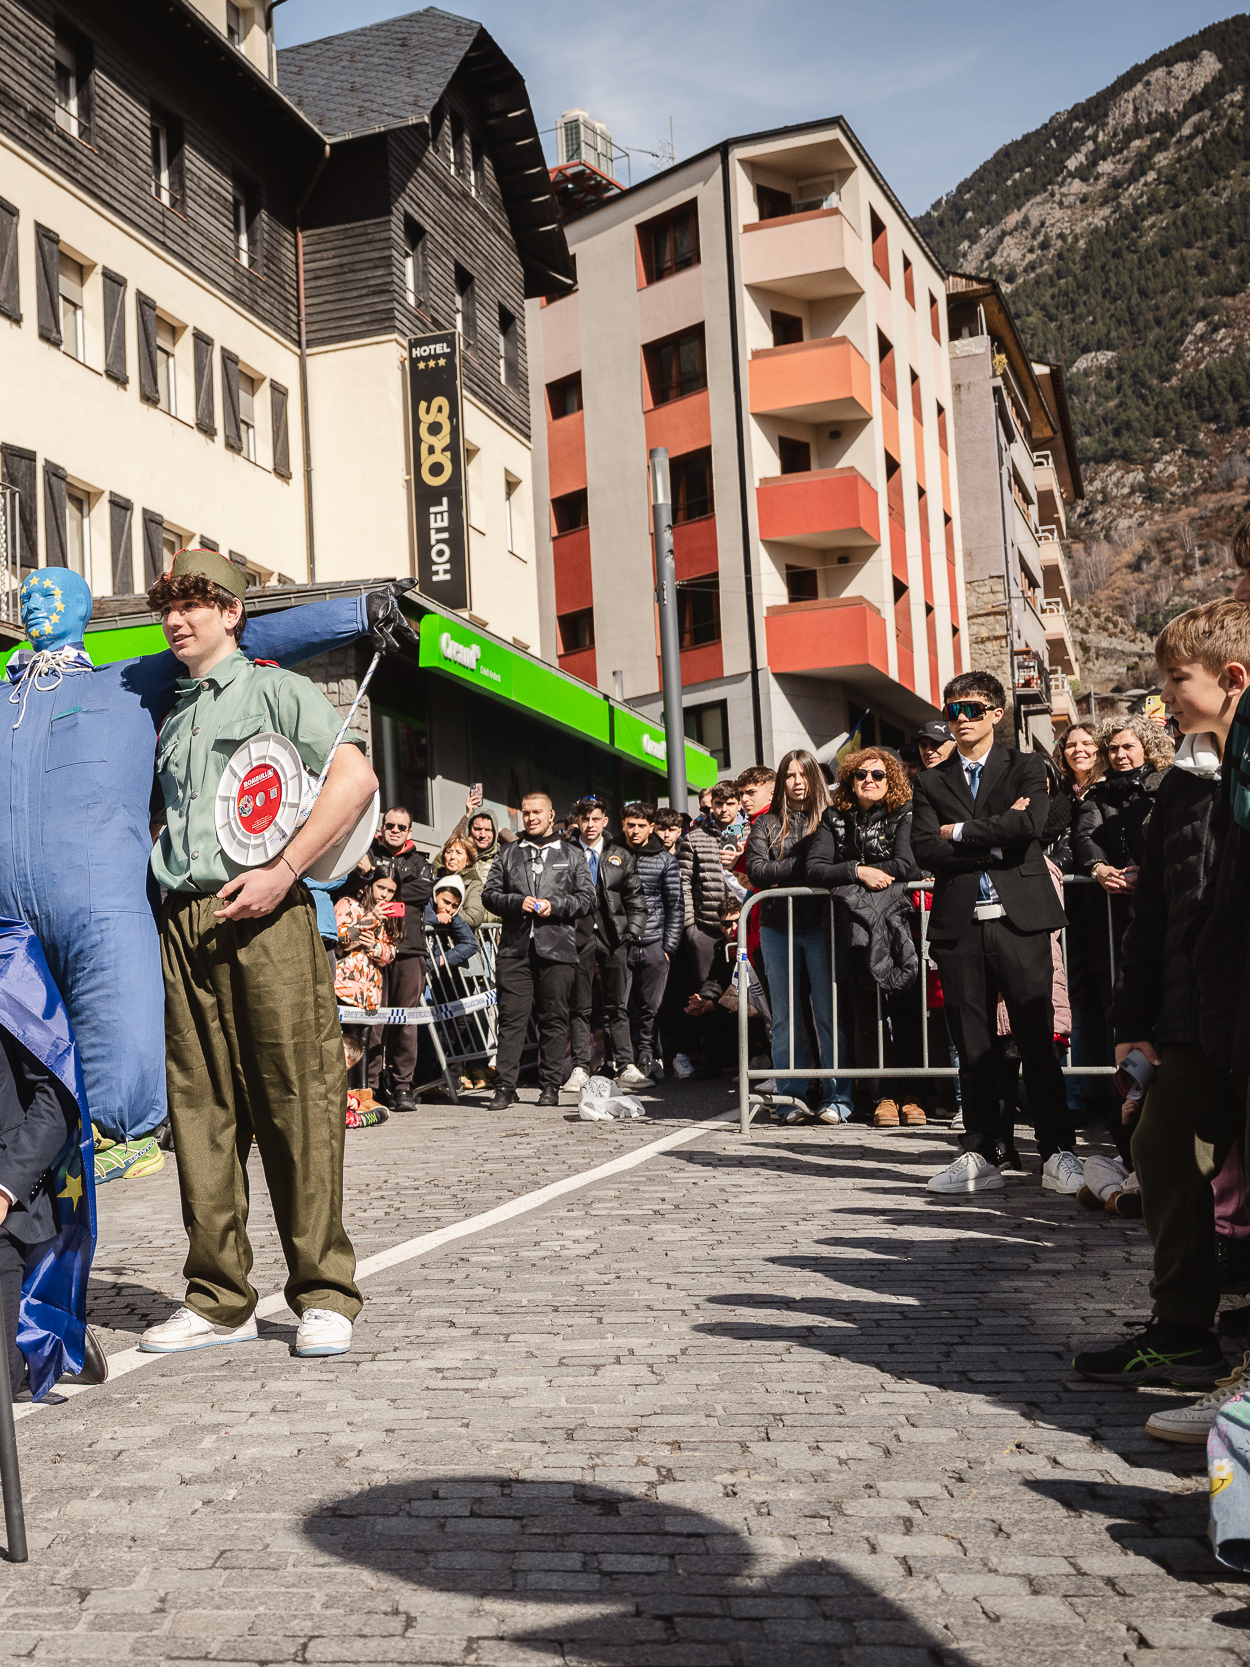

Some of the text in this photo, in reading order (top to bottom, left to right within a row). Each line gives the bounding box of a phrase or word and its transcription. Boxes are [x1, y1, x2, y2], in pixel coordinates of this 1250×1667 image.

[412, 342, 451, 358] HOTEL
[419, 396, 452, 582] HOTEL OROS
[243, 771, 267, 788] ROMBULL
